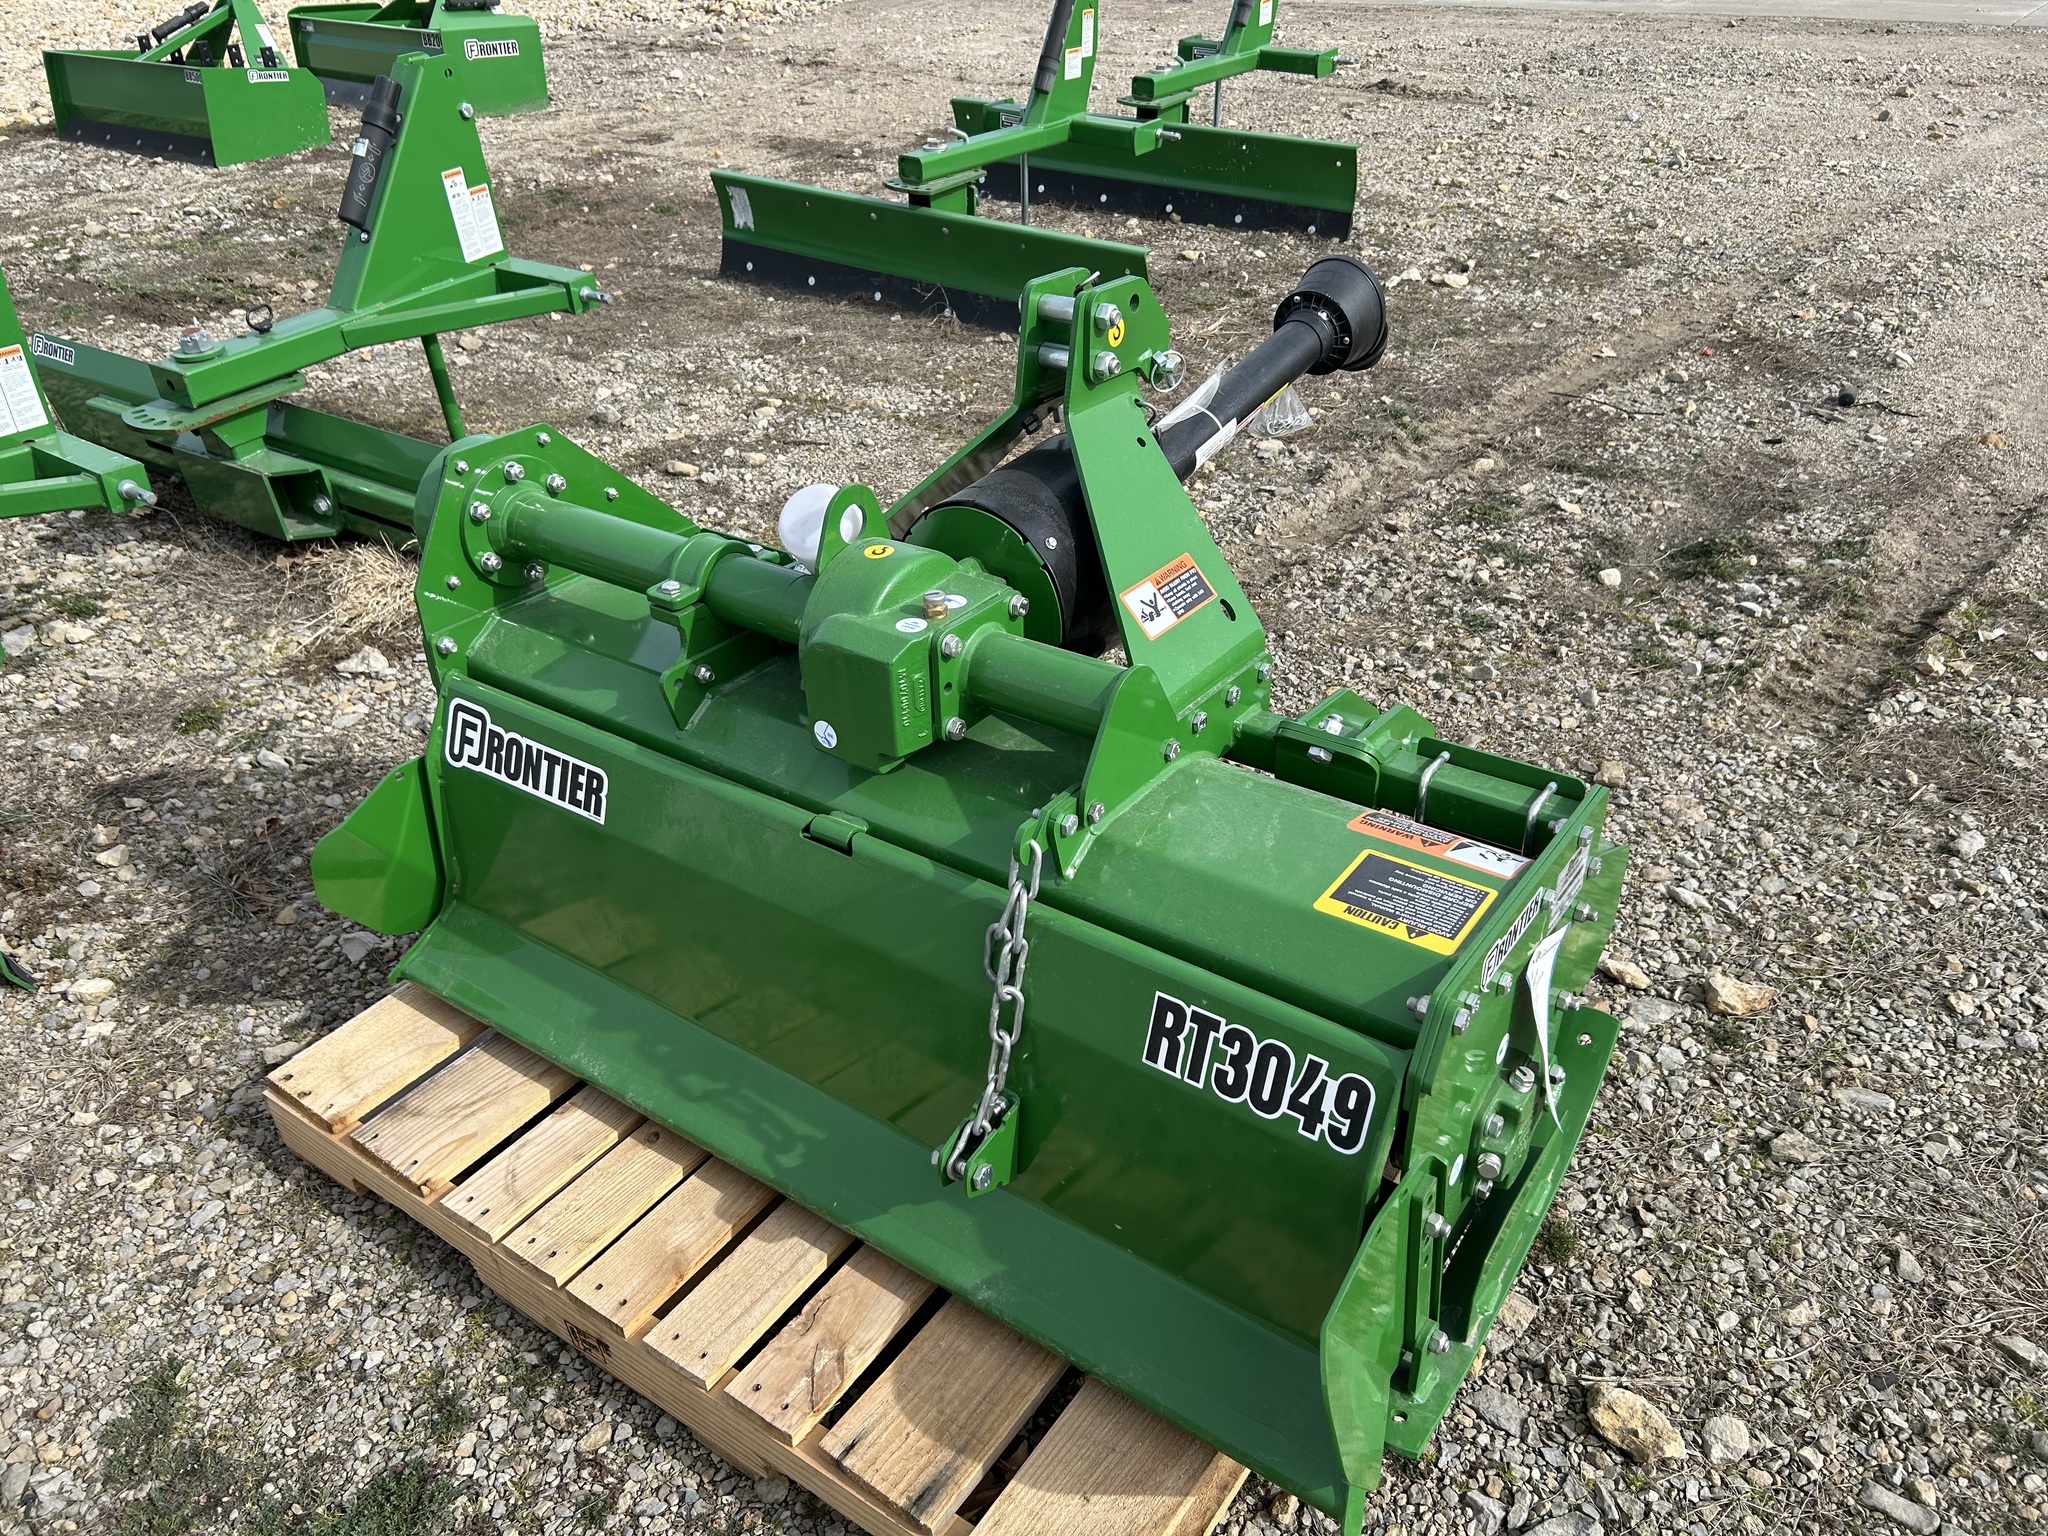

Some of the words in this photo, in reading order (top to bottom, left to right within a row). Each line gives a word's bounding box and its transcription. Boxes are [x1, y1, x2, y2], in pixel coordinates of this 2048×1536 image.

[423, 32, 441, 48] BB20
[466, 41, 518, 58] FRONTIER
[249, 71, 288, 80] FRONTIER
[34, 335, 74, 363] FRONTIER
[1159, 561, 1187, 581] WARNING
[450, 702, 605, 818] FRONTIER
[1359, 820, 1414, 839] WARNING
[1388, 877, 1441, 897] DISMOUNTING
[1422, 884, 1464, 900] SERVICING
[1442, 895, 1475, 908] BEFORE
[1344, 906, 1399, 929] CAUTION
[1397, 917, 1426, 929] INJURY
[1427, 927, 1452, 937] AVOID
[1481, 892, 1542, 989] FRONTIER
[1145, 995, 1372, 1150] RT3049
